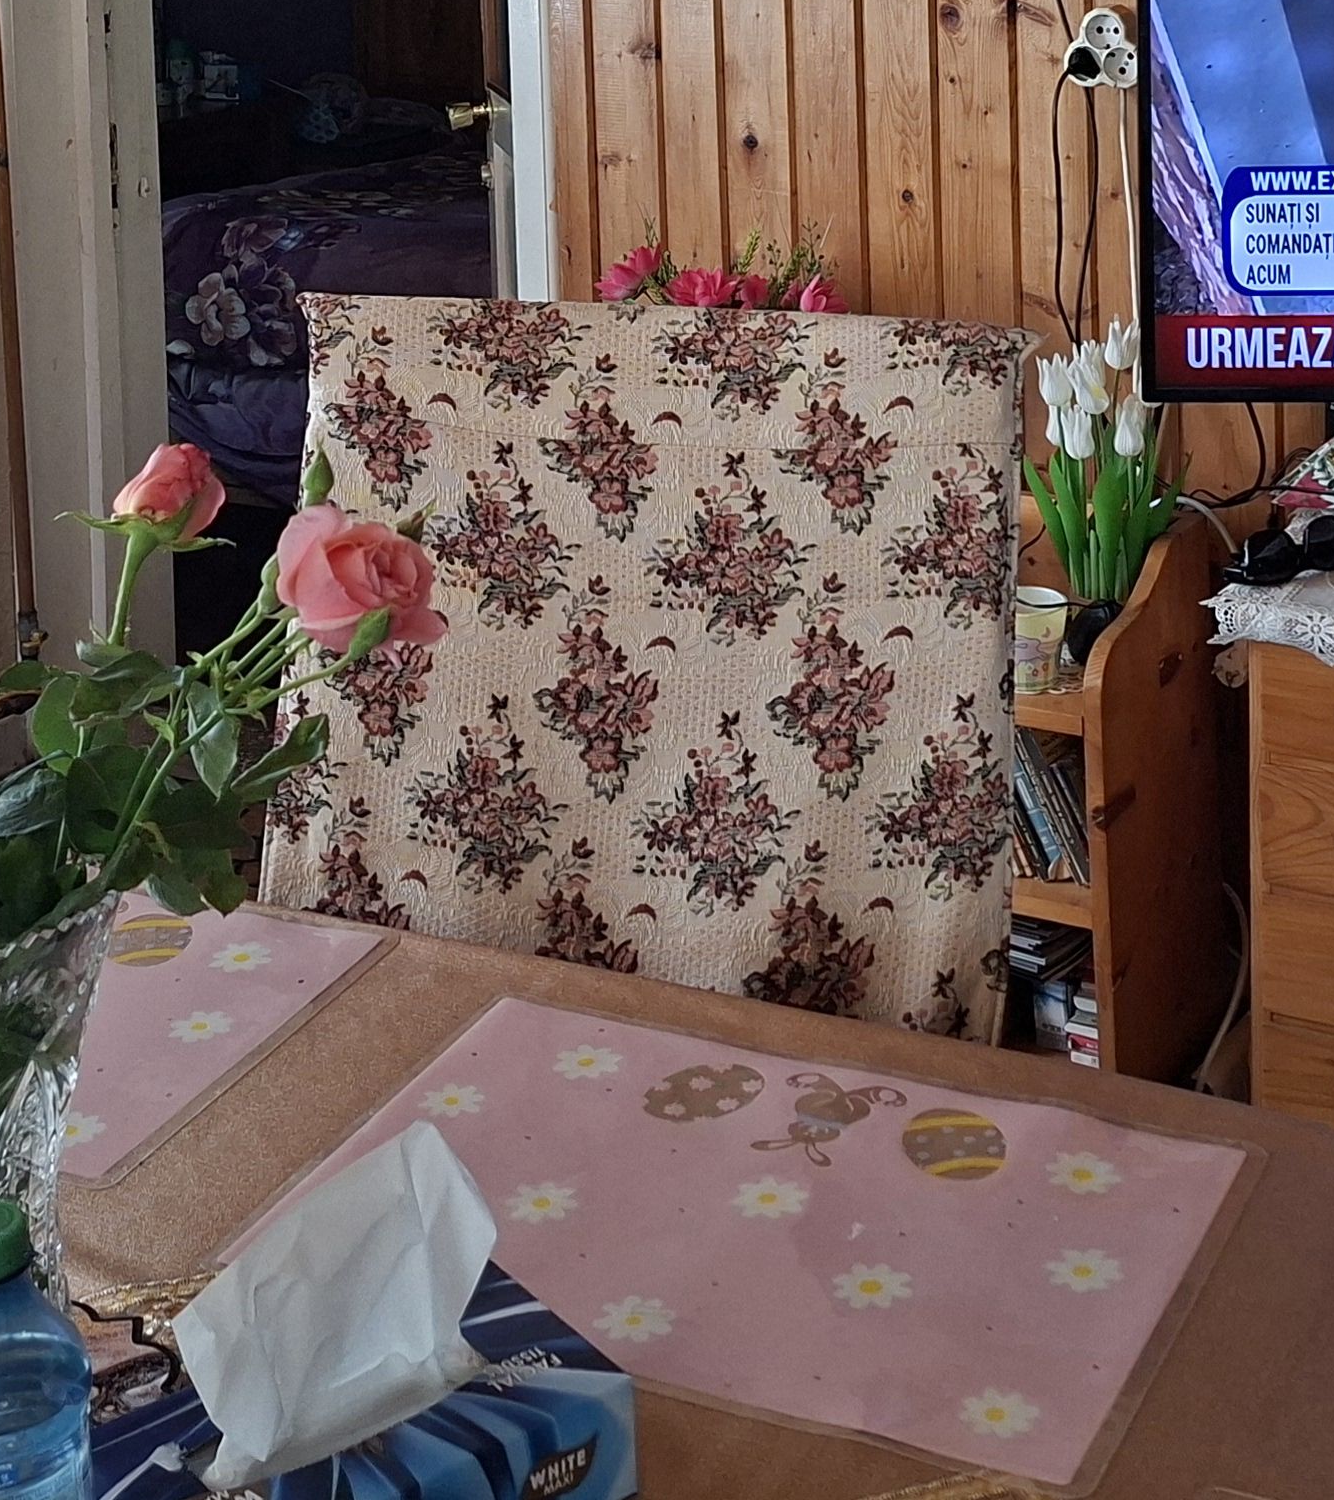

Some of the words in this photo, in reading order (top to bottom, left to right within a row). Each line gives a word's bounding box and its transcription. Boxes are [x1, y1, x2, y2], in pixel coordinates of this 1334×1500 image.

[1245, 202, 1302, 229] SUNAȚI
[1305, 203, 1320, 229] ȘI
[1245, 264, 1291, 285] ACUM
[487, 1352, 563, 1392] FACIAL
[529, 1448, 587, 1491] WHITE
[542, 1472, 575, 1497] MAXI
